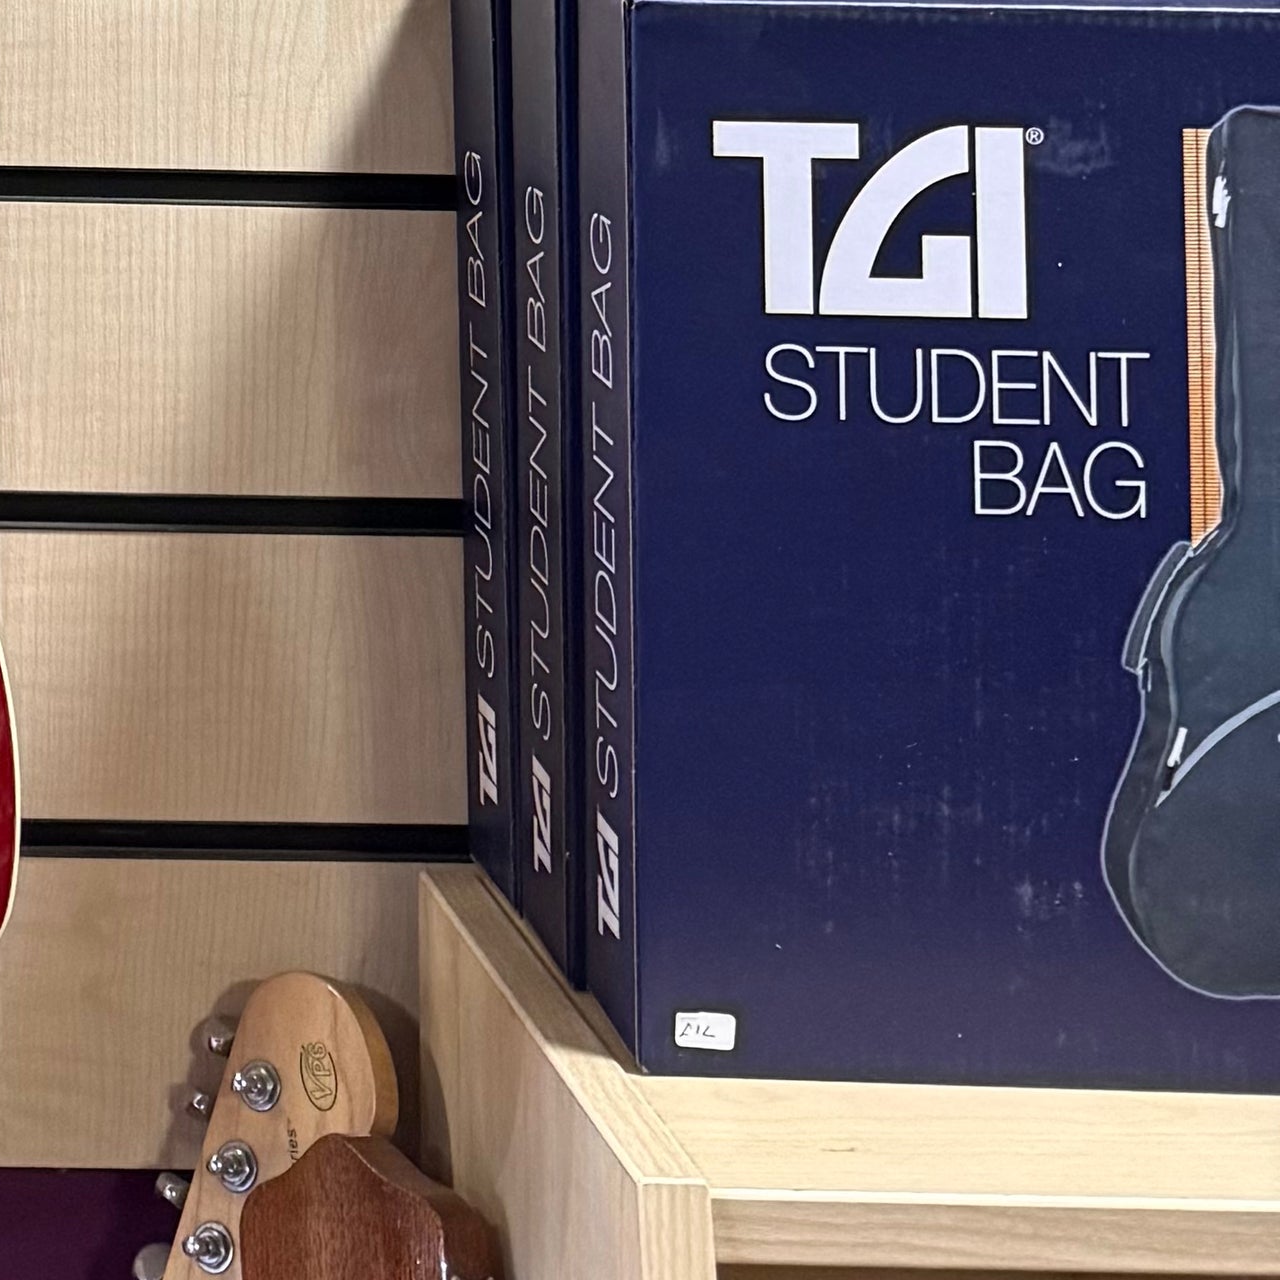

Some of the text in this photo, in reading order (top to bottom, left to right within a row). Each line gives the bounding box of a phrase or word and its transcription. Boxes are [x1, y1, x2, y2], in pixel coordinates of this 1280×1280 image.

[463, 150, 498, 806] TGI STUDENT BAG
[524, 185, 553, 874] TGI STUDENT BAG
[763, 342, 1151, 428] STUDENT
[972, 440, 1148, 520] BAG
[589, 212, 620, 940] TGI STUDENT BAG
[286, 1128, 298, 1162] ries
